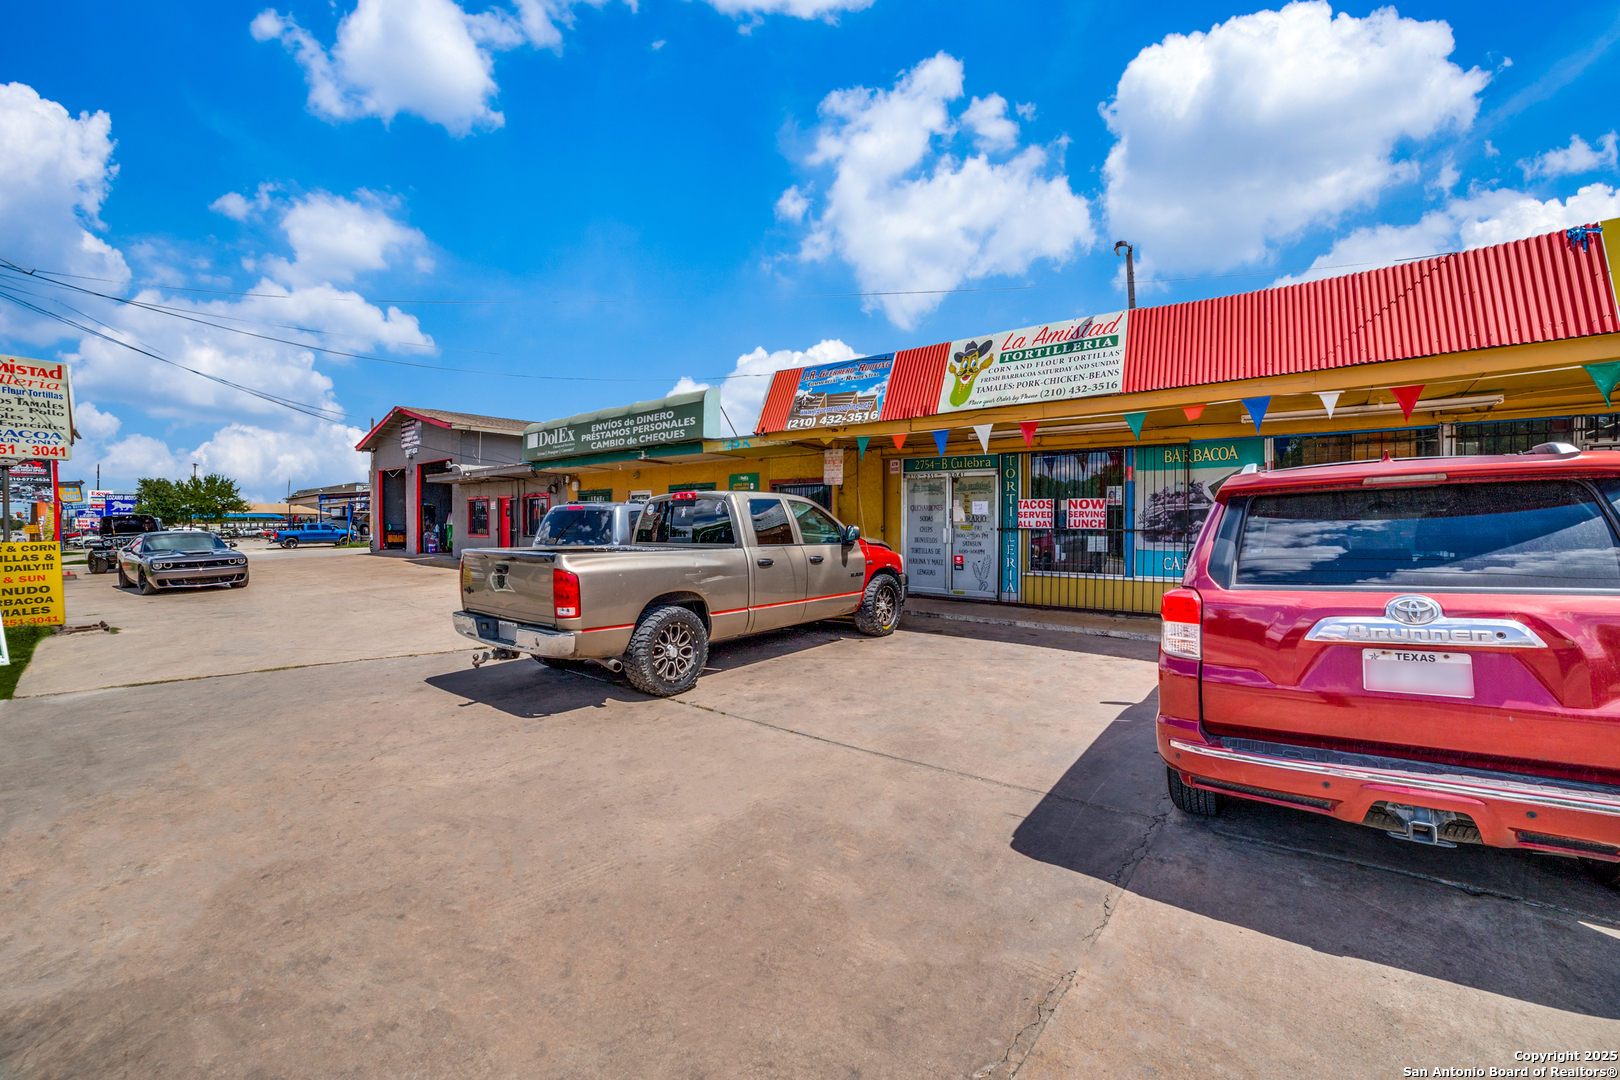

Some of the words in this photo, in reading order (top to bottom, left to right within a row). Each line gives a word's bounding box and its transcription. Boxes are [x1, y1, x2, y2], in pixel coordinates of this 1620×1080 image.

[1001, 332, 1026, 351] La
[1031, 313, 1124, 346] Amistad
[1002, 340, 1114, 362] TORTILLERIA
[988, 366, 1012, 374] CORN
[1014, 362, 1033, 371] AND
[1035, 358, 1065, 369] FLOUR
[1067, 350, 1121, 363] TORTILLAS
[980, 375, 1001, 383] FRESH
[1001, 370, 1037, 380] BARBACOA
[1037, 364, 1073, 375] SATURDAY
[1073, 363, 1090, 371] AND
[1090, 358, 1121, 369] SUNDAY
[976, 382, 1015, 394] TAMALES:
[1016, 368, 1120, 389] PORK-CHICKEN-BEANS
[2, 386, 26, 396] Flour
[28, 388, 64, 400] Tortillas
[1039, 388, 1067, 399] (210)
[1068, 380, 1118, 395] 432-3516
[591, 420, 622, 432] ENVÍOS
[624, 418, 635, 427] de
[636, 410, 675, 425] DINERO
[787, 417, 816, 429] (210)
[819, 410, 879, 425] 432-3516
[581, 427, 631, 442] PRÉSTAMOS
[632, 416, 696, 435] PERSONALES
[25, 438, 60, 446] ONLY
[539, 427, 575, 447] DolEx
[590, 438, 625, 450] CAMBIO
[627, 437, 638, 445] de
[639, 429, 686, 443] CHEQUES
[31, 445, 66, 457] 3041
[1163, 445, 1239, 463] BARBACOA
[914, 458, 948, 470] 2754-B
[950, 457, 992, 469] Culebra
[1018, 500, 1053, 510] TACOS
[1069, 499, 1106, 510] NOW
[1018, 511, 1054, 519] SERVED
[1005, 455, 1016, 593] TORTILLERIA
[1036, 520, 1053, 528] DAY
[1069, 519, 1106, 528] LUNCH
[21, 544, 57, 552] CORN
[911, 547, 934, 555] TORTILLAS
[44, 553, 55, 561] &
[4, 563, 54, 572] DAILY!!!
[3, 576, 14, 584] &
[18, 574, 46, 583] SUN
[1, 585, 51, 596] NUDO
[1347, 623, 1494, 643] 4RUNNER
[1394, 652, 1437, 663] TEXAS
